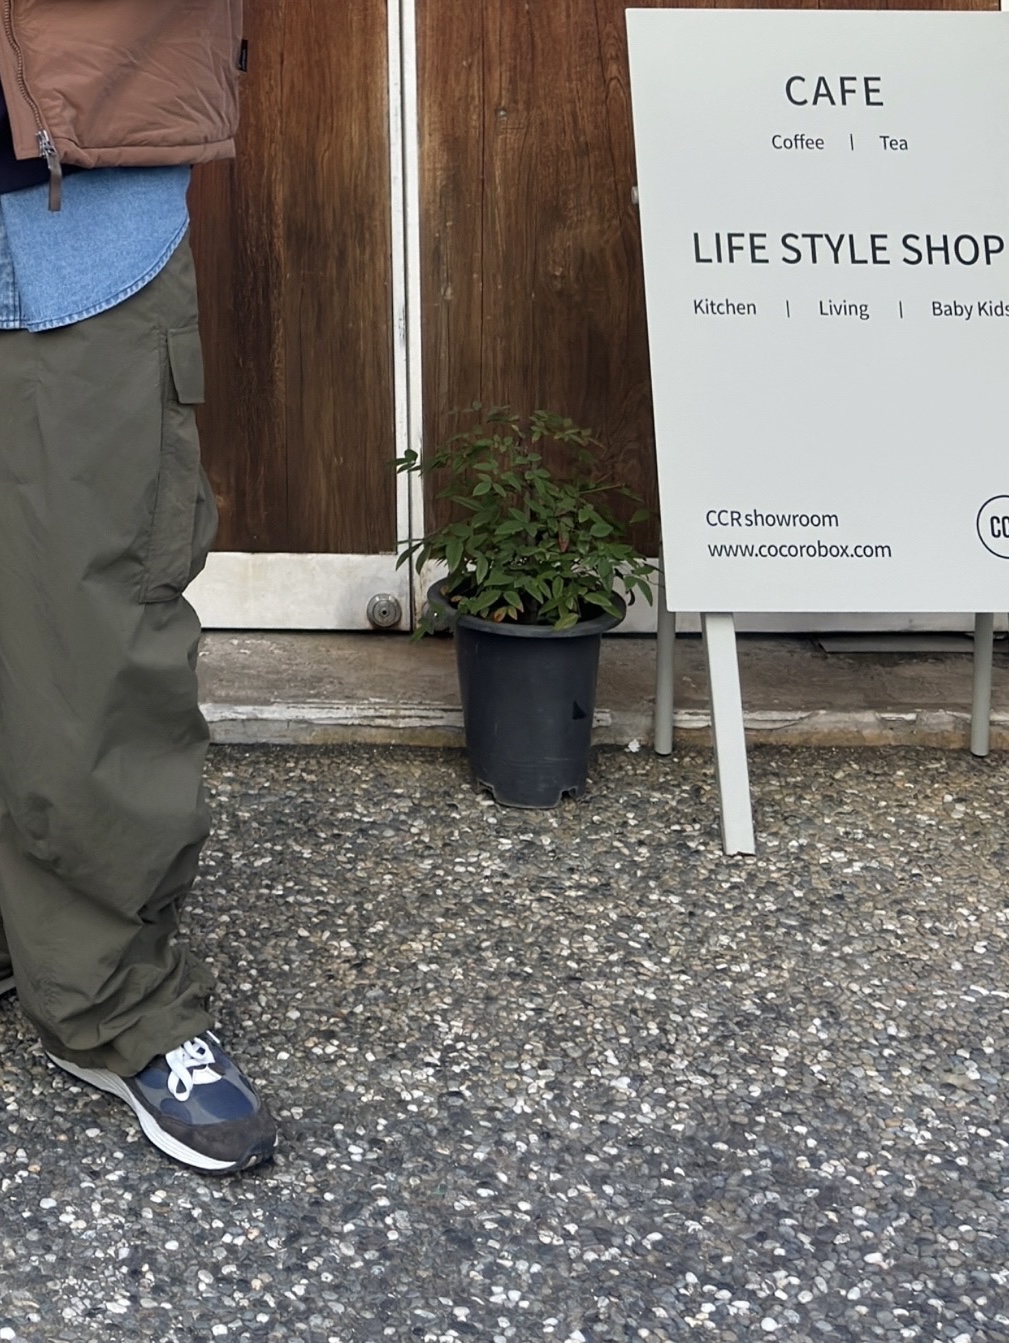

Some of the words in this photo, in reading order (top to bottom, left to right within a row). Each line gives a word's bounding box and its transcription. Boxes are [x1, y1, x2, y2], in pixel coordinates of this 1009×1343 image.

[785, 75, 884, 106] CAFE
[771, 134, 825, 150] Coffee
[879, 135, 909, 150] Tea
[693, 232, 770, 264] LIFE
[781, 233, 891, 265] STYLE
[901, 233, 1005, 265] SHOP
[693, 299, 757, 316] Kitchen
[819, 299, 870, 320] Living
[932, 300, 973, 320] Baby
[706, 509, 742, 527] CCR
[744, 509, 839, 527] showroom
[990, 515, 1009, 539] CC
[707, 540, 892, 558] www.cocorobox.com
